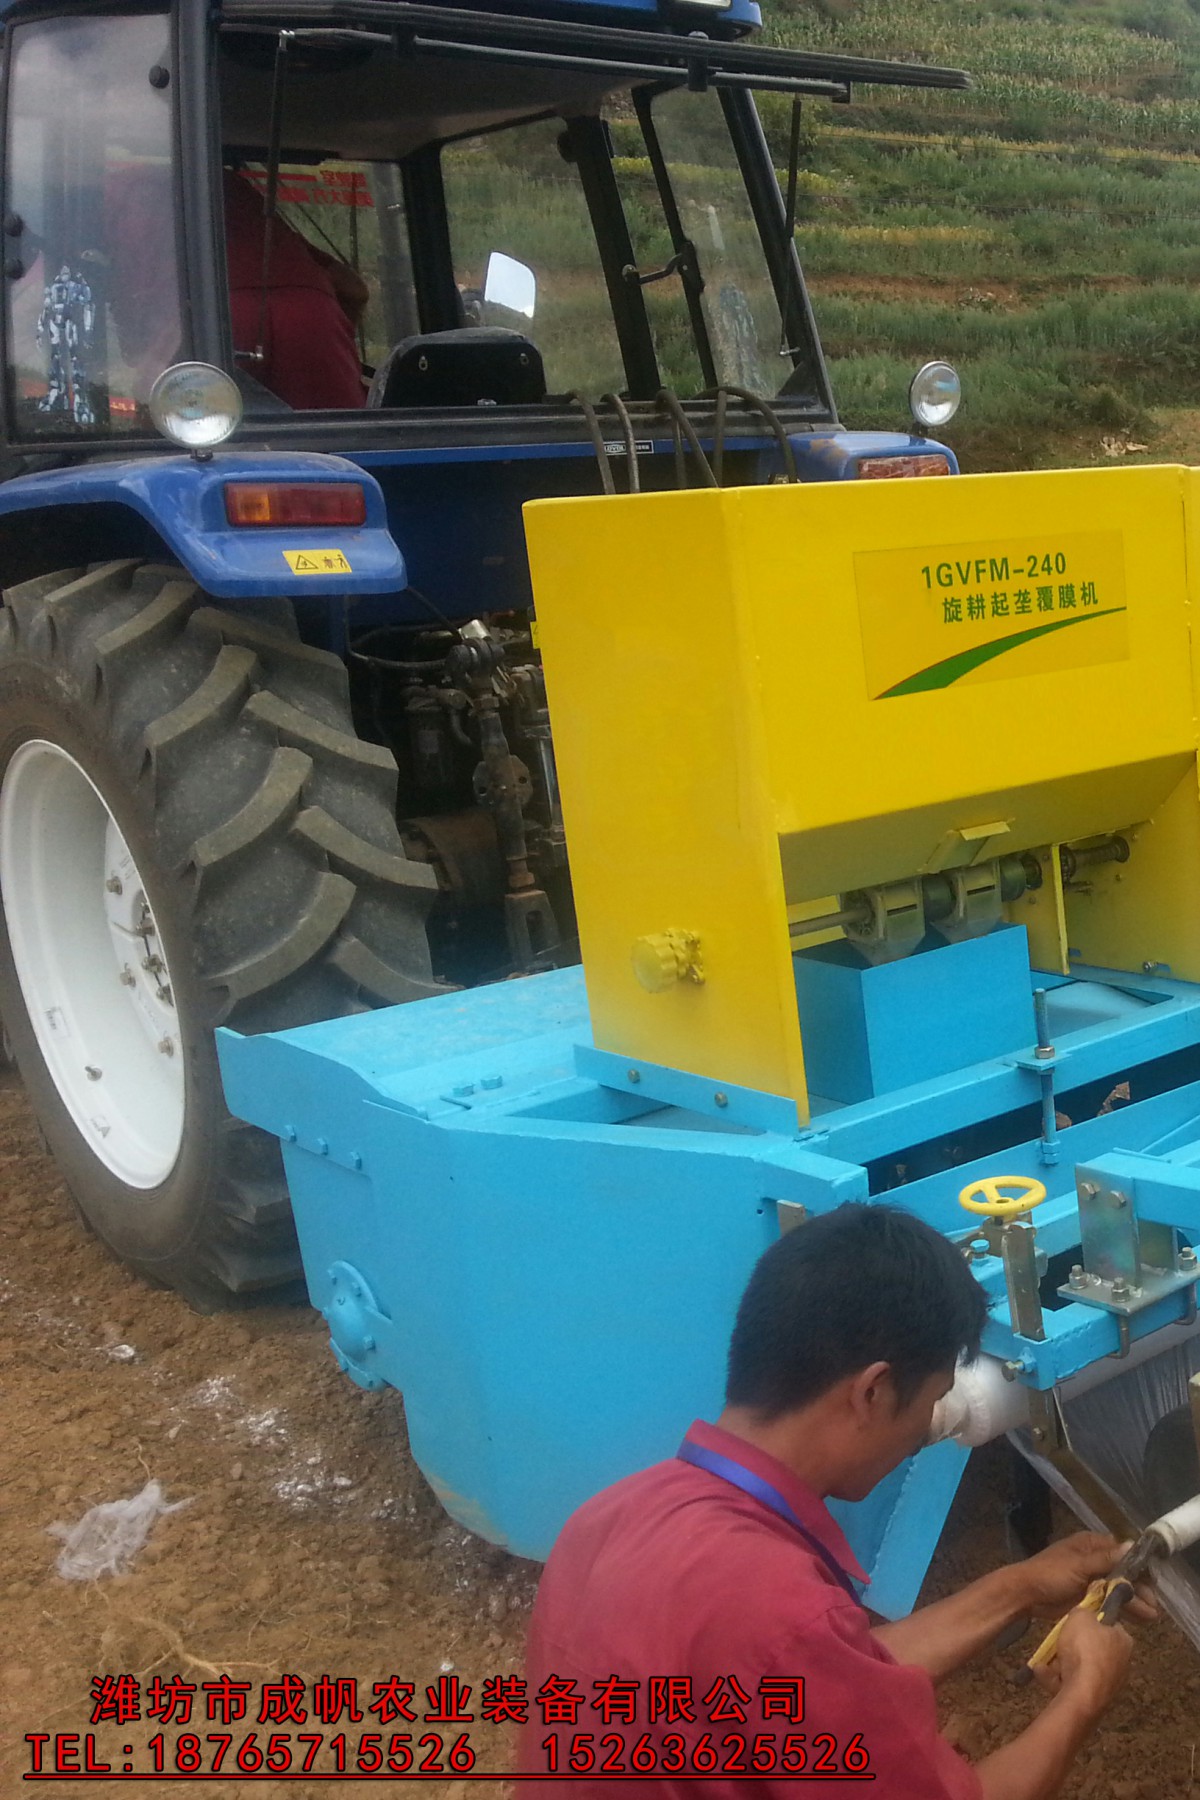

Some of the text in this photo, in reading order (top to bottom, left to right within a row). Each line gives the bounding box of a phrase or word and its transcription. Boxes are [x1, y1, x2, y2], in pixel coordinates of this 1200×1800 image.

[921, 552, 1067, 589] 1GVFM-240
[943, 581, 1099, 624] 旋耕起垄覆膜机
